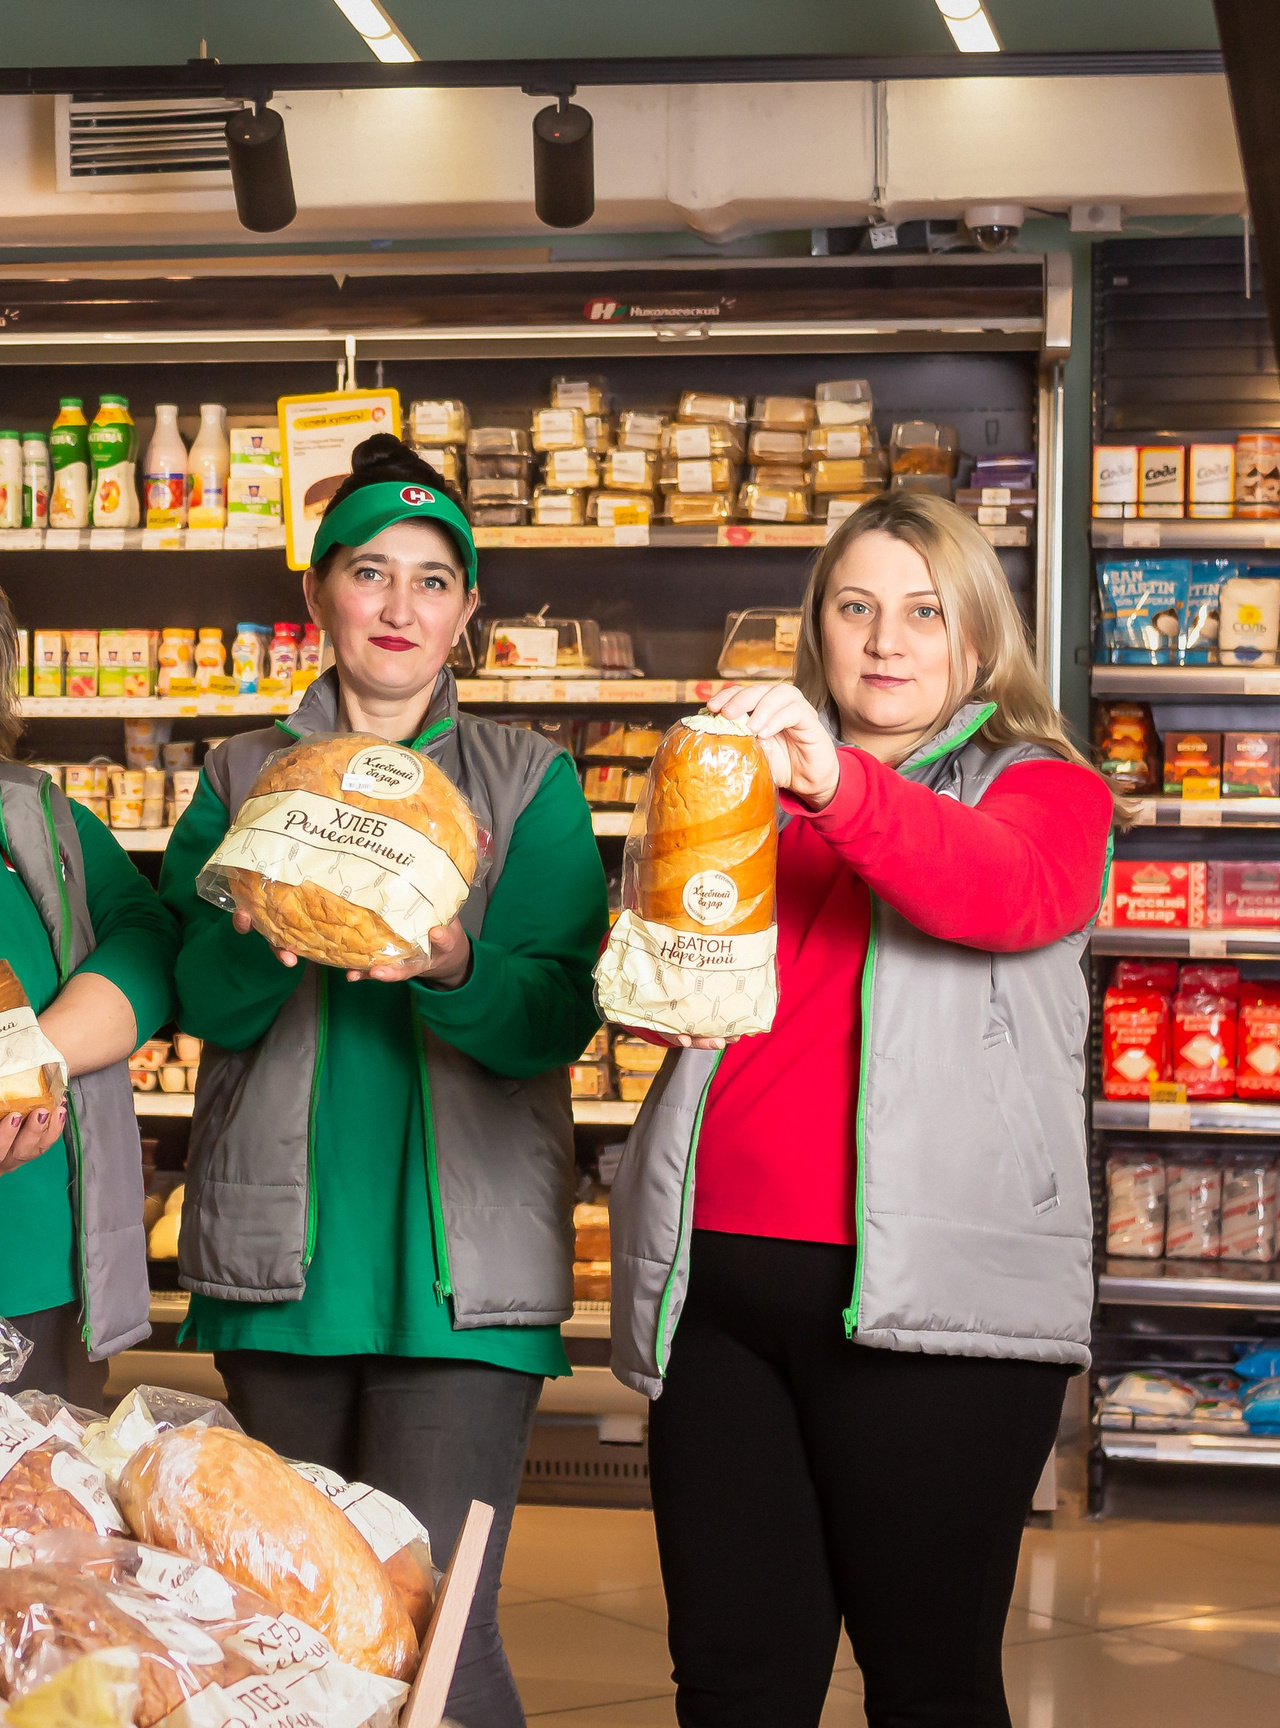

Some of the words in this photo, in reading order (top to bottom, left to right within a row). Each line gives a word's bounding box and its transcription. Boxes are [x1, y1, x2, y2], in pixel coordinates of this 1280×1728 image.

[629, 306, 720, 316] Николаевский
[1145, 465, 1177, 480] Сода
[1110, 570, 1143, 584] SAN
[1111, 581, 1175, 597] MARTIN
[1232, 623, 1267, 633] СОЛЬ
[362, 756, 415, 781] Хлебный
[366, 768, 400, 787] базар
[329, 808, 388, 838] ХЛЕБ
[284, 810, 415, 866] Ремесленный
[693, 885, 731, 899] Хлебный
[698, 897, 722, 910] базар
[1116, 894, 1186, 911] Русский
[1226, 892, 1280, 911] Русски
[1126, 909, 1176, 924] сахар
[677, 935, 733, 954] БАТОН
[660, 940, 737, 968] Нарезной
